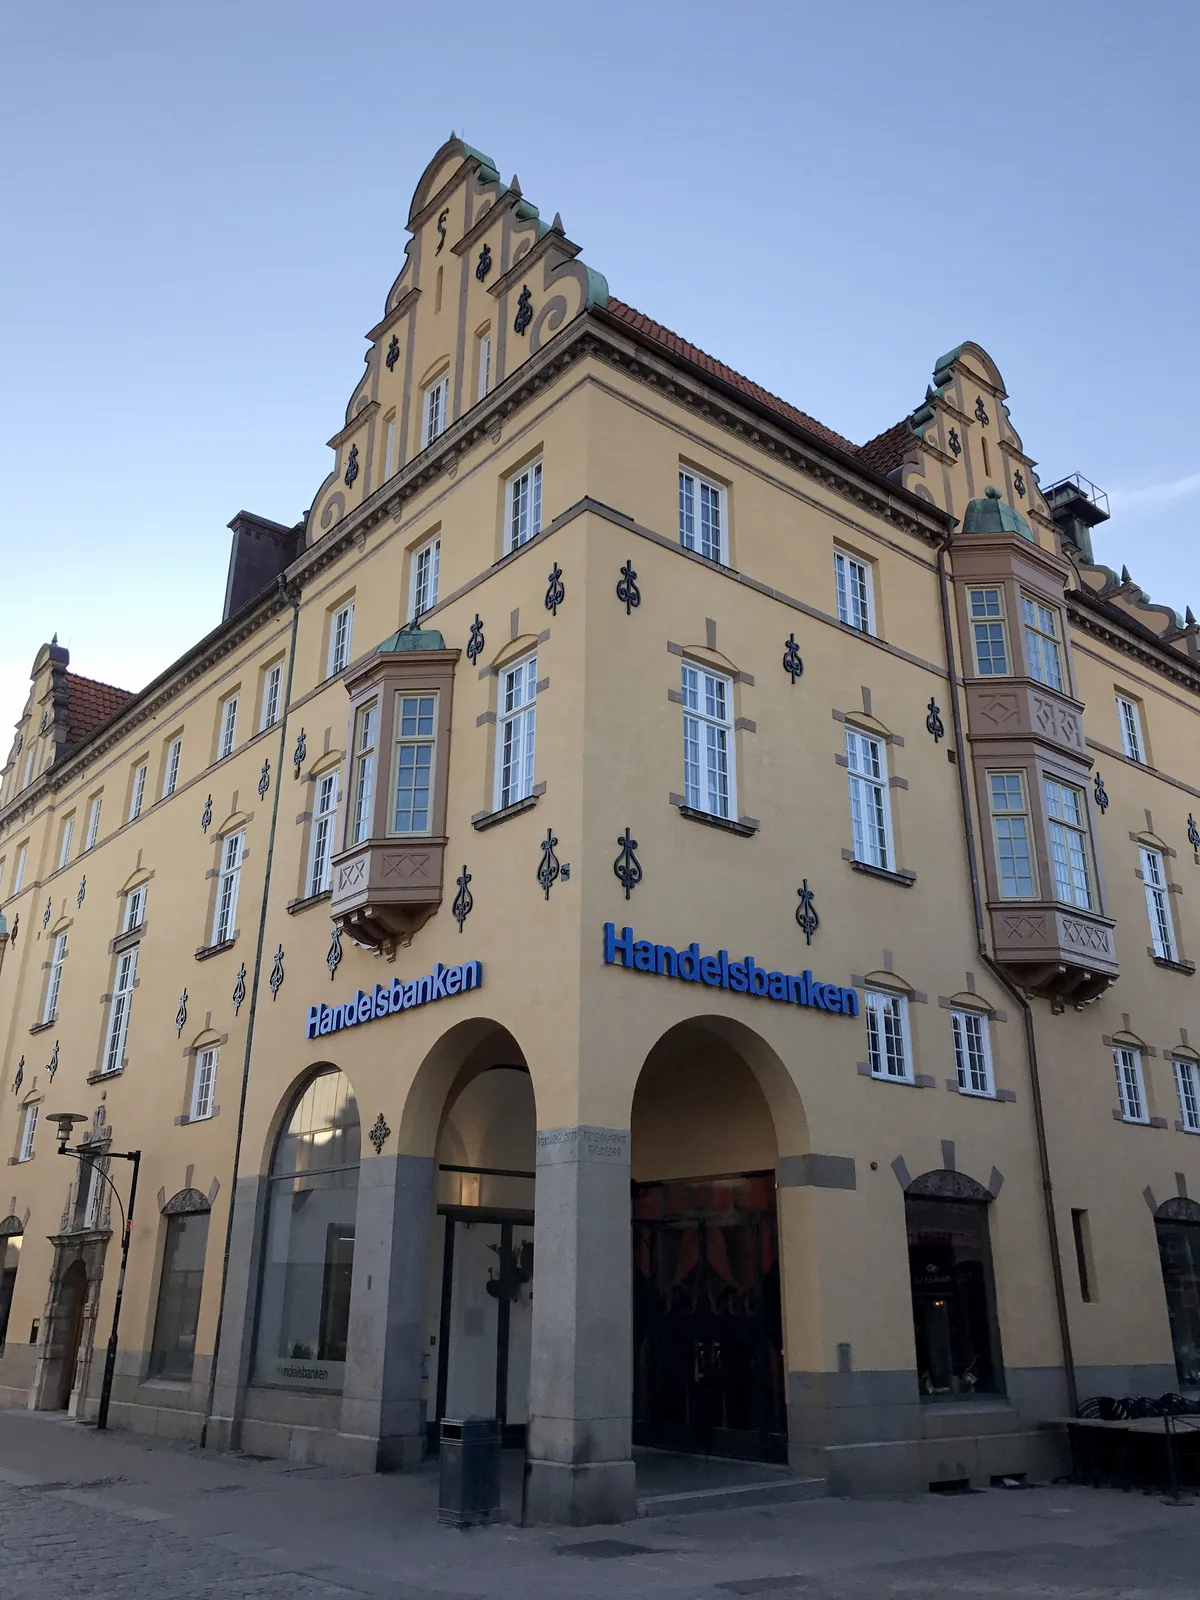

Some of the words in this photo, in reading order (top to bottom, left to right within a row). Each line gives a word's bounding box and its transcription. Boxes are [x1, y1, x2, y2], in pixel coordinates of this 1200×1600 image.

[305, 960, 483, 1039] Handelsbanken
[604, 922, 859, 1016] Handelsbanken
[275, 1363, 328, 1380] Hndelsbanken
